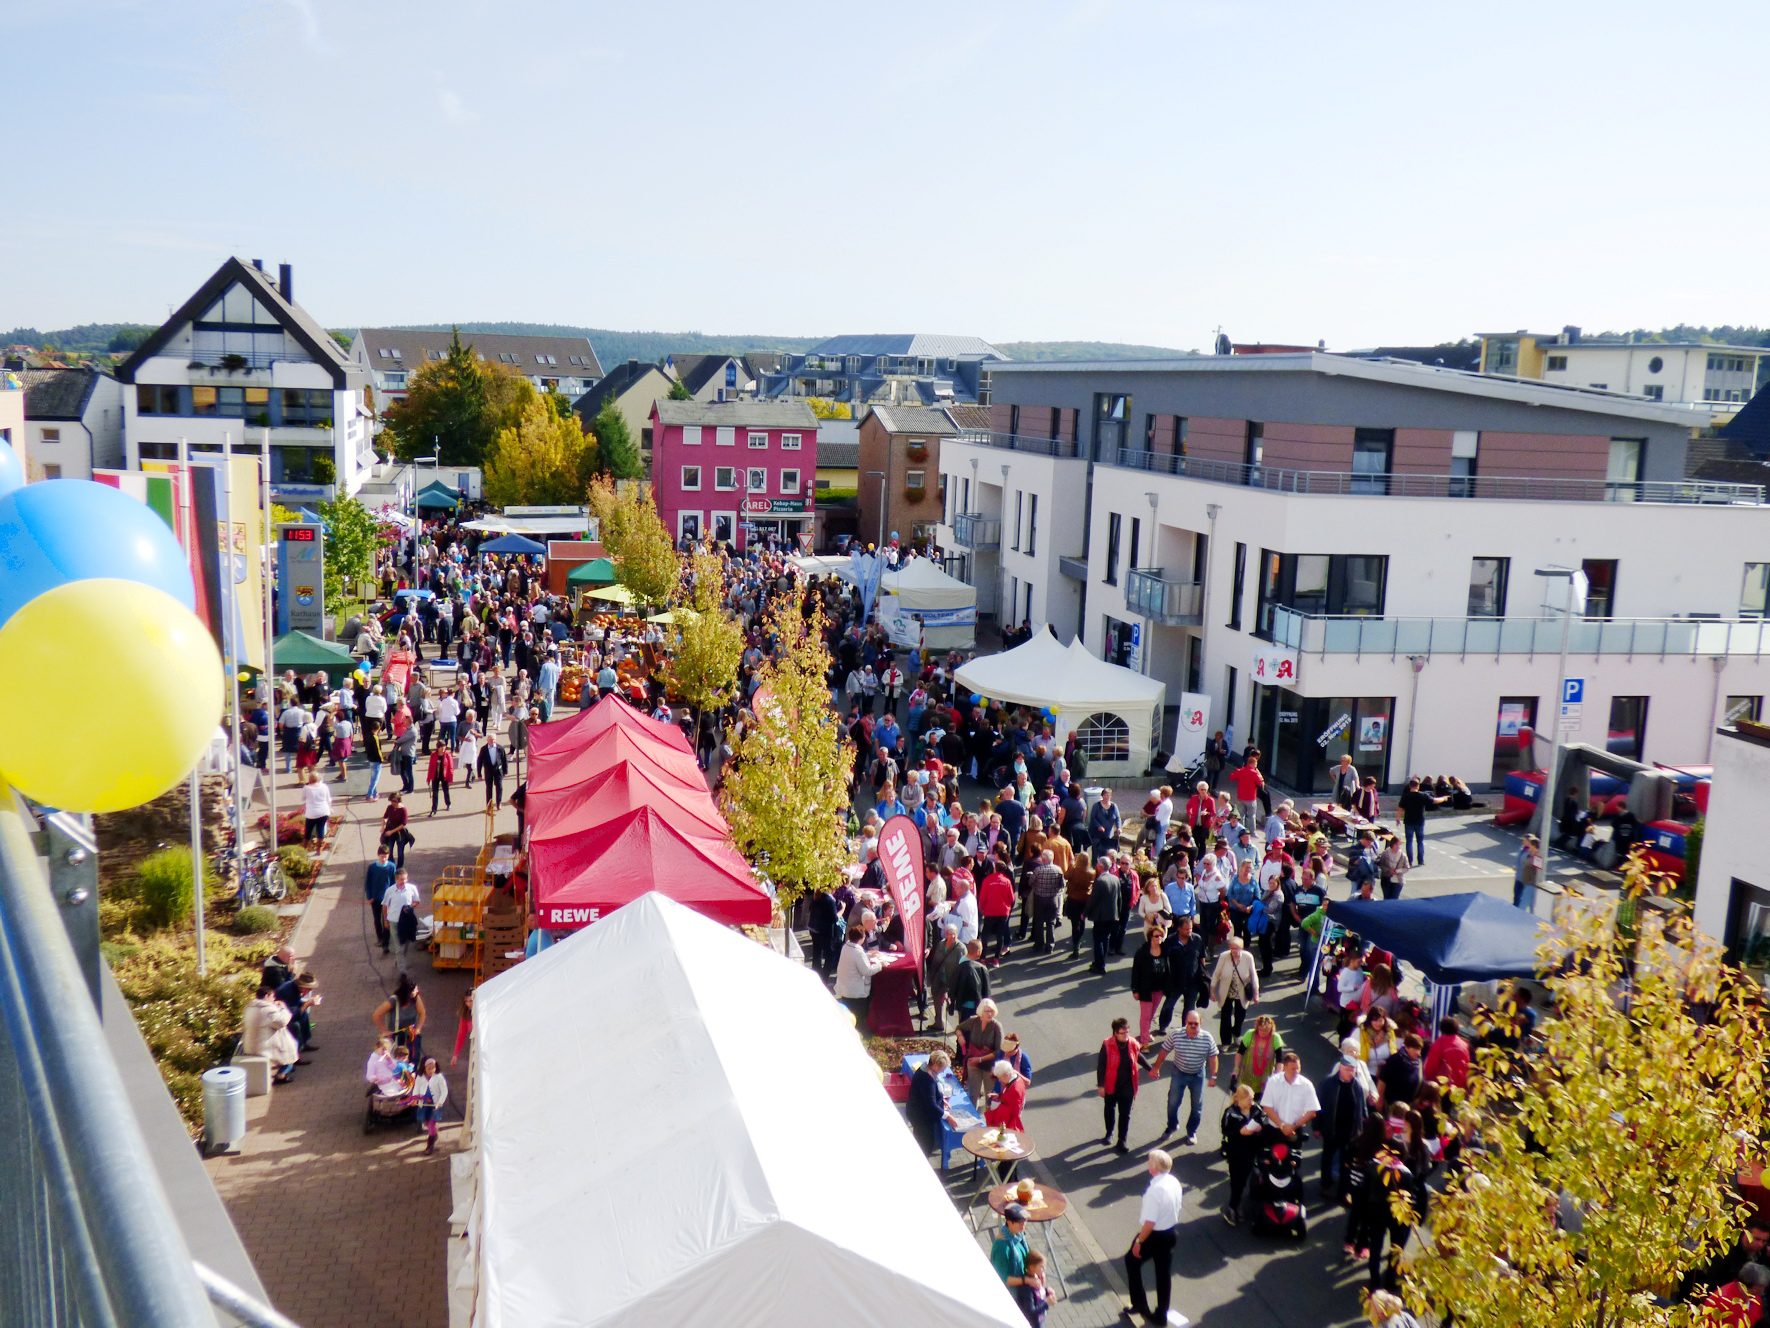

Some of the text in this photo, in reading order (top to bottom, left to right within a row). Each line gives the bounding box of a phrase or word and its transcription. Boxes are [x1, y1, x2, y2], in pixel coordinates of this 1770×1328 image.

[747, 501, 769, 510] AREL
[1134, 626, 1139, 642] P
[1566, 682, 1580, 700] P
[1317, 714, 1348, 744] ERÖFFNUNG
[1320, 740, 1330, 748] 02.
[1339, 717, 1352, 730] 2015
[885, 828, 921, 921] REWE
[551, 908, 600, 922] REWE
